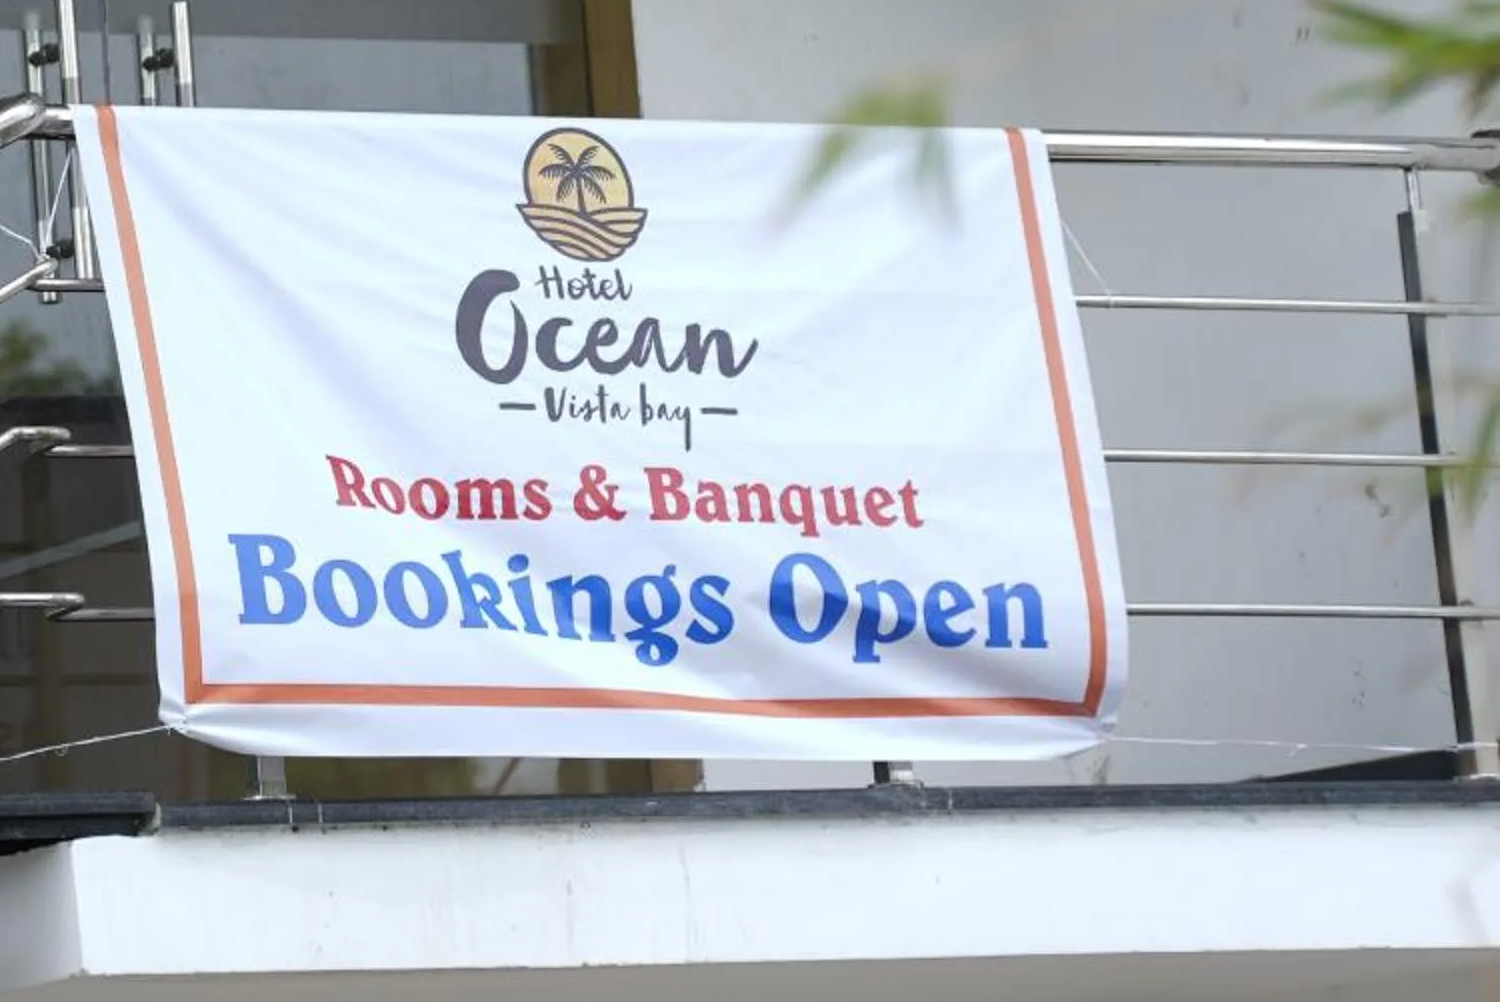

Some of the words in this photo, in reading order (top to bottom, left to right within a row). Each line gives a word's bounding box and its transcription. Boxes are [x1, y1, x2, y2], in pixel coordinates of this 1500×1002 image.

[535, 266, 632, 300] Hotel
[456, 270, 758, 384] Ocean
[545, 384, 630, 423] Vista
[640, 384, 691, 451] bay
[327, 456, 551, 522] Rooms
[575, 466, 626, 523] &
[644, 468, 925, 539] Banquet
[228, 533, 735, 667] Bookings
[769, 552, 1049, 664] Open
